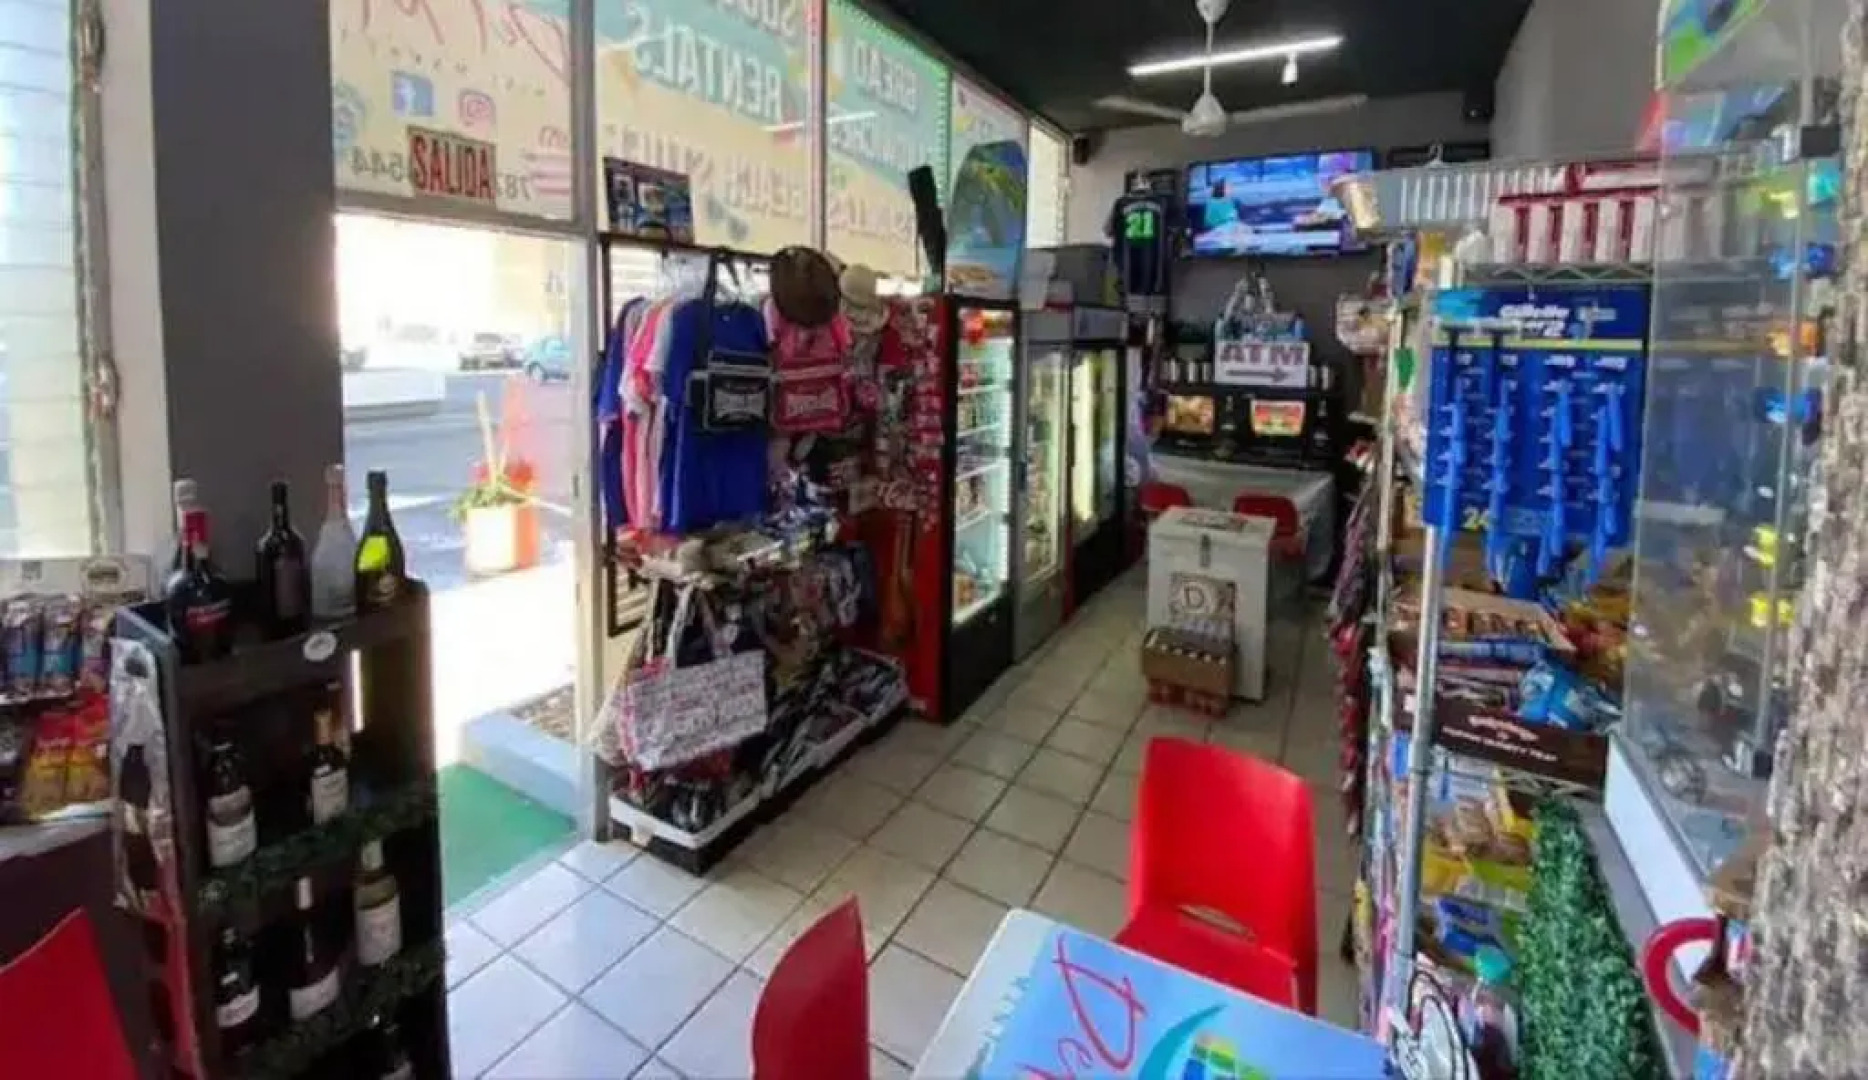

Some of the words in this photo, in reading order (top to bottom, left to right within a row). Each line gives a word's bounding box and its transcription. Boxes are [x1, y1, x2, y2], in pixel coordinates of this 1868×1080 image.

[408, 133, 496, 201] SALIDA
[1126, 210, 1154, 239] 21
[1220, 343, 1305, 366] ATM
